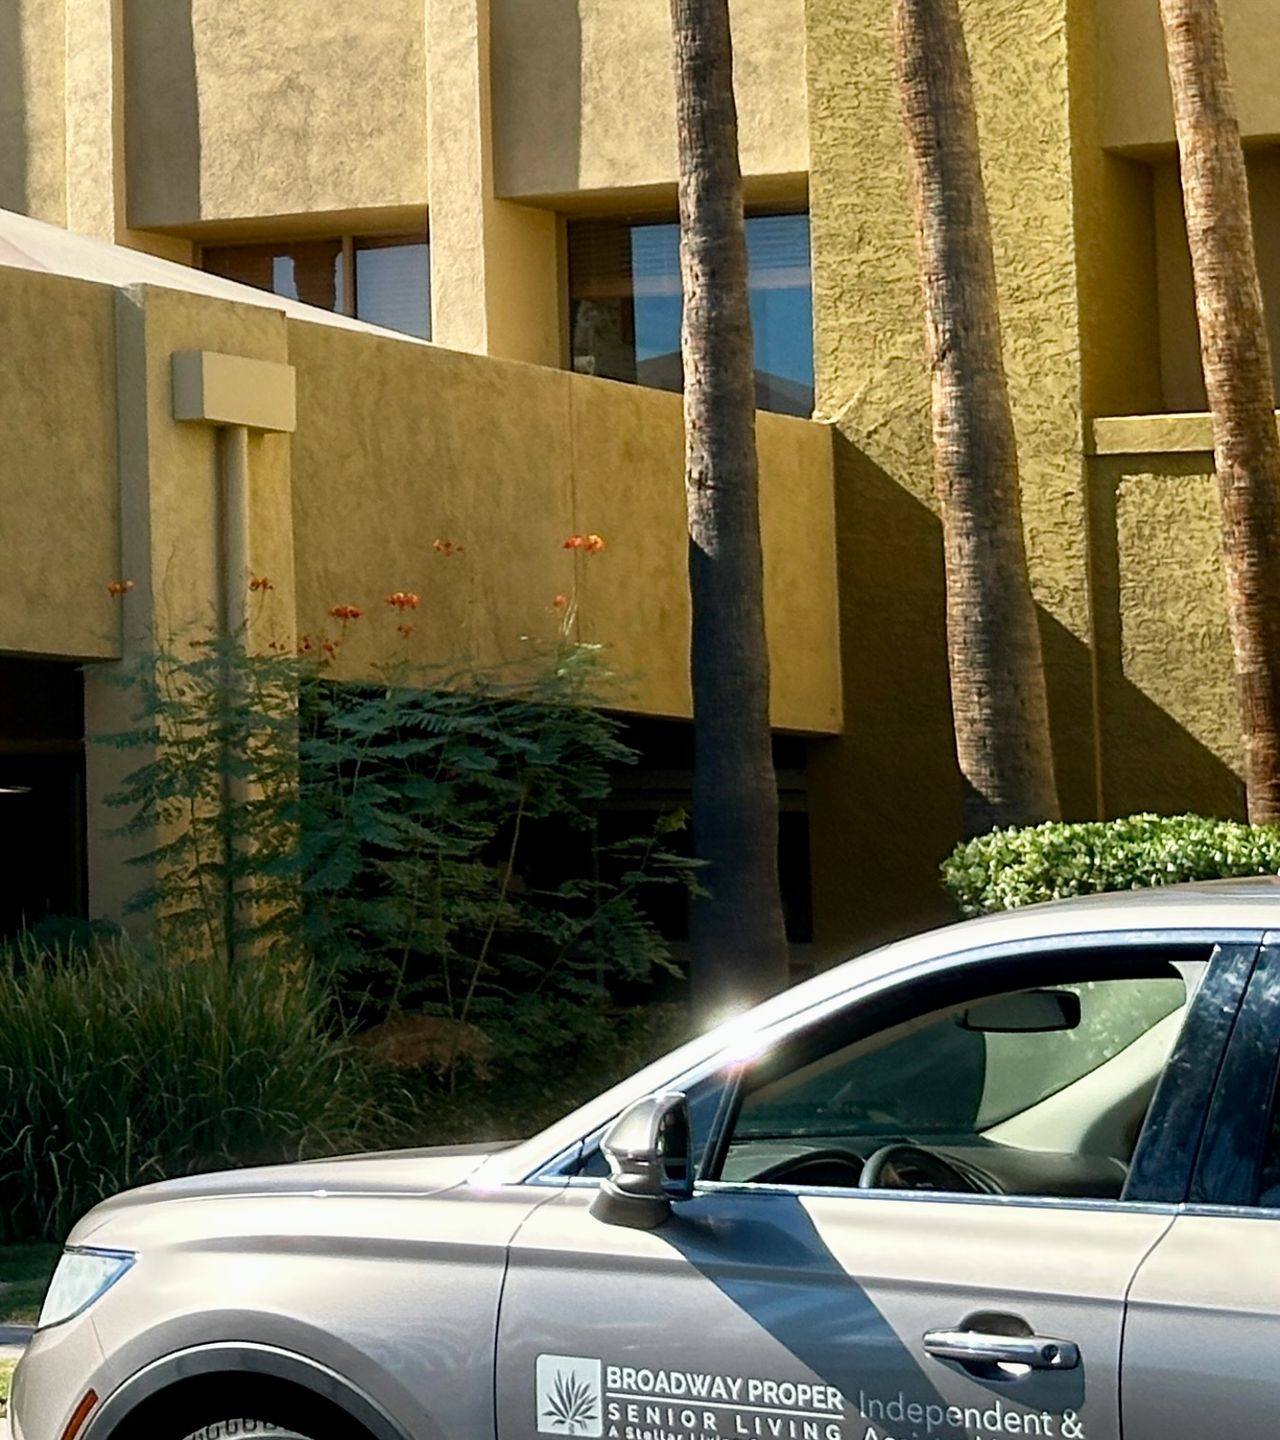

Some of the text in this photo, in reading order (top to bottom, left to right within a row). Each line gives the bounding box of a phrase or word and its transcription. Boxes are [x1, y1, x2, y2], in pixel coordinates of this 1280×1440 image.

[605, 1365, 845, 1410] BROADWAY PROPER
[606, 1402, 718, 1430] SENIOR
[735, 1414, 842, 1440] LIVING
[608, 1424, 619, 1438] A
[858, 1389, 1087, 1440] Independent &
